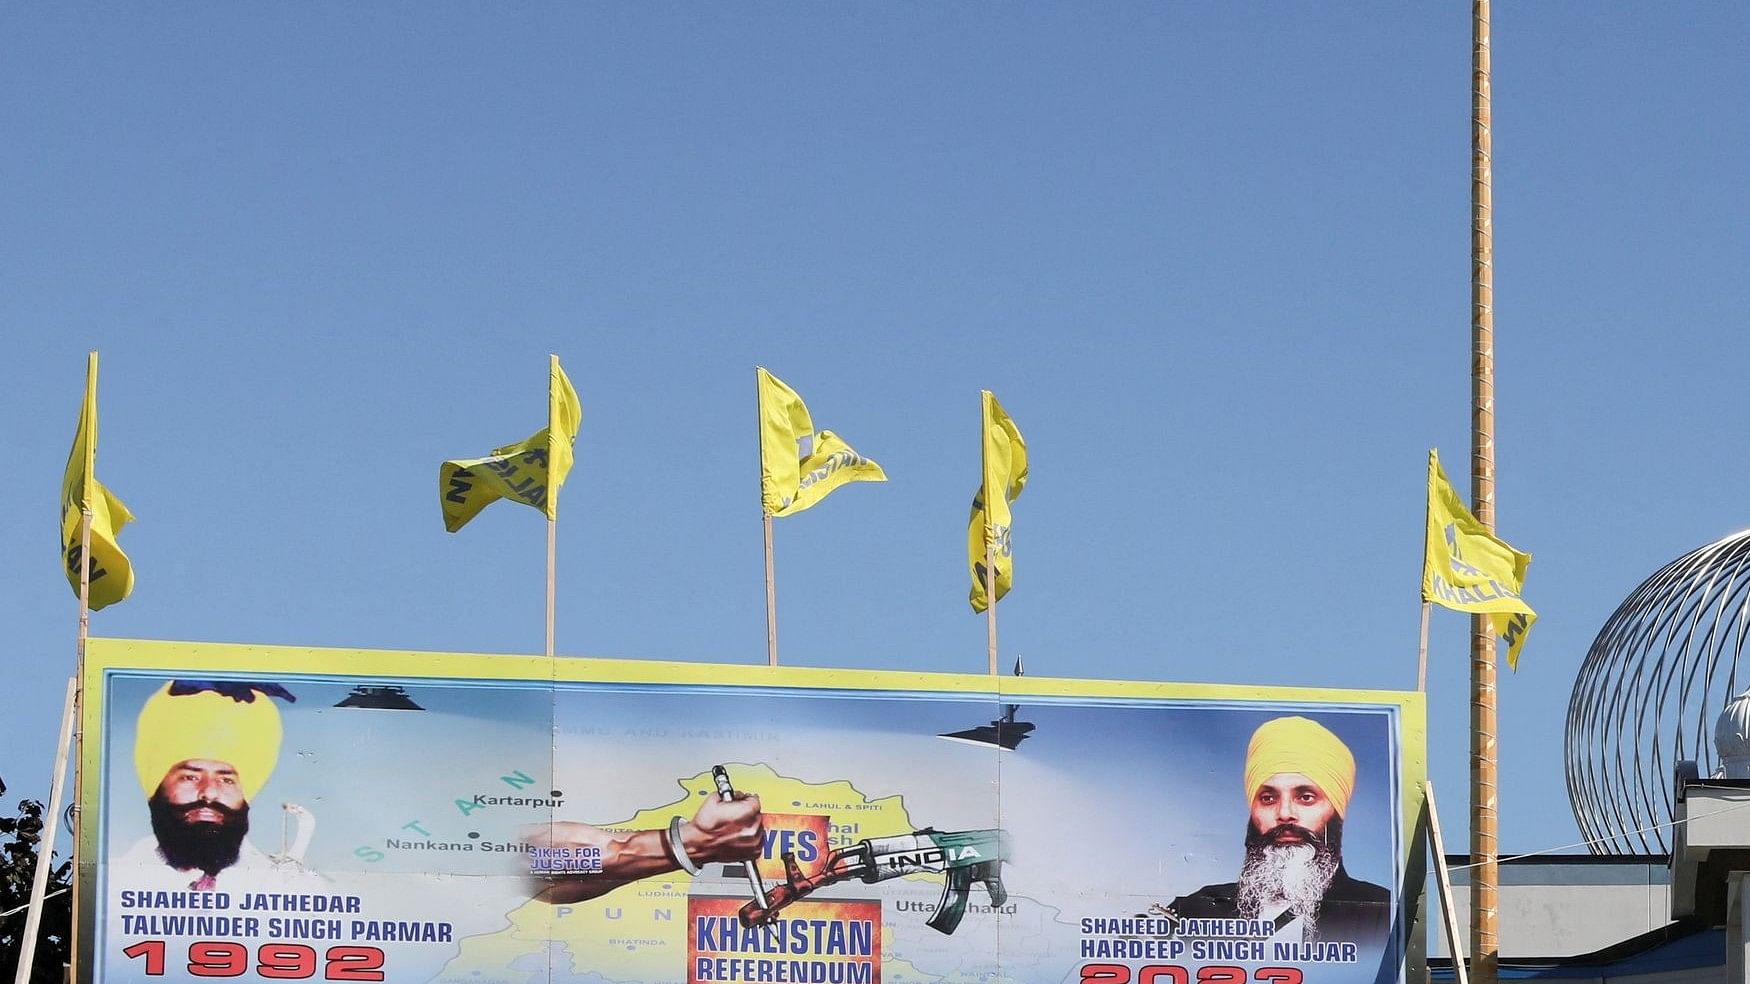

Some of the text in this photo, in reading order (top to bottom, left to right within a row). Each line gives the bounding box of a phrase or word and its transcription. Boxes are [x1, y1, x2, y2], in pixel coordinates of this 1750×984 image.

[474, 794, 565, 808] Kartarpur
[386, 838, 536, 854] Nankana Sahib
[530, 847, 601, 858] SIKHS FOR
[763, 829, 818, 862] YES
[889, 845, 982, 869] INDIA
[531, 859, 601, 869] JUSTICE
[121, 889, 361, 914] SHAHEED JATHEDAR
[121, 914, 453, 943] TALWINDER SINGH PARMAR
[697, 912, 872, 957] KHALISTAN
[1080, 917, 1276, 938] SHAHEED JATHEDAR
[123, 940, 385, 982] 1992
[1080, 938, 1357, 964] HARDEEP SINGH NIJJAR
